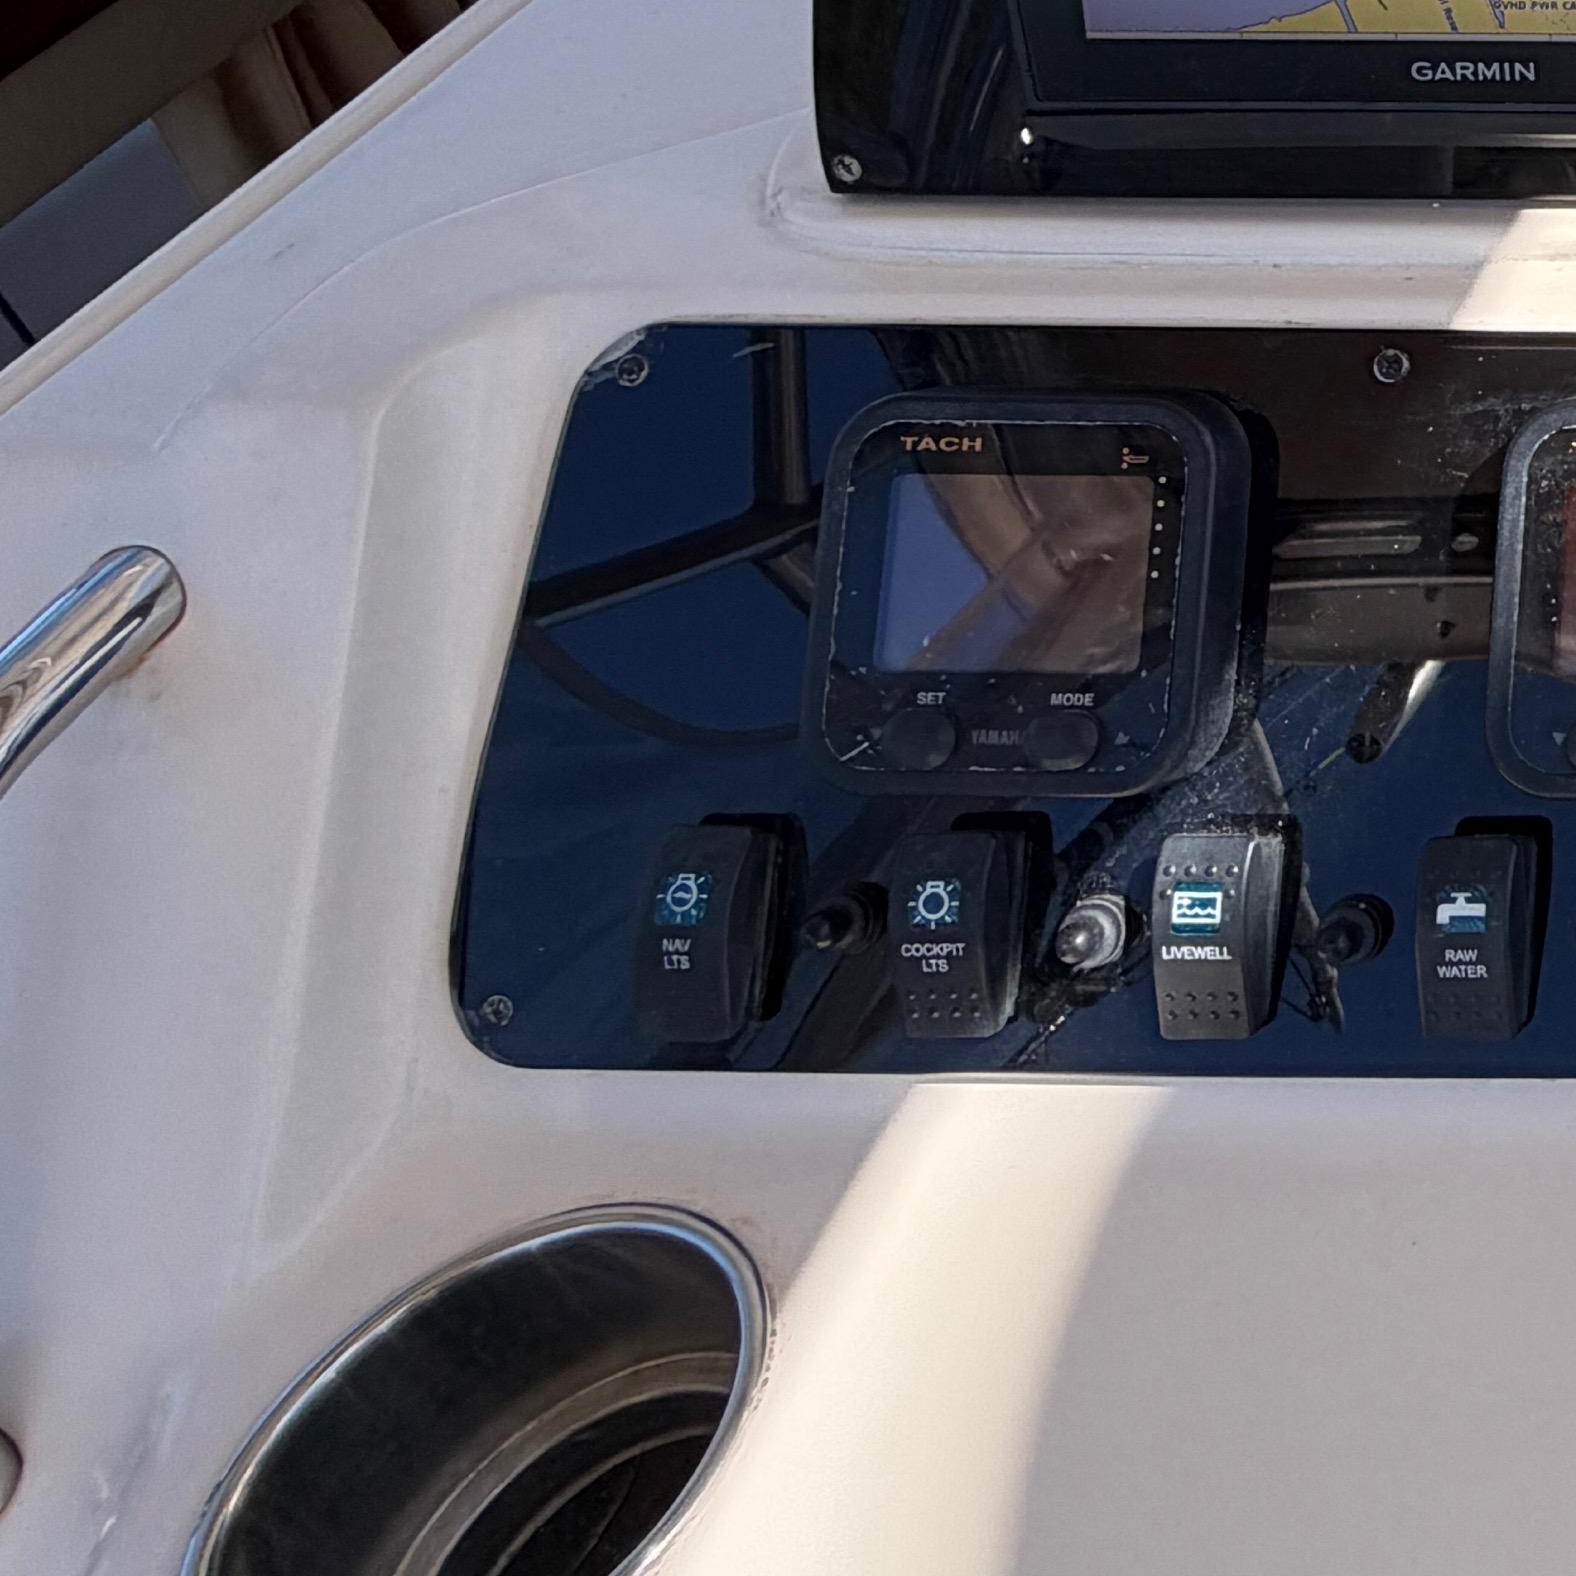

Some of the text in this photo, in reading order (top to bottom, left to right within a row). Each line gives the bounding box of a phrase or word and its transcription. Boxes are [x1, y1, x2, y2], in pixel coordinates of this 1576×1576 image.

[1410, 61, 1536, 82] GARMIN
[899, 435, 984, 454] TACH
[916, 692, 1096, 708] SET MODE
[661, 937, 693, 954] NAV
[900, 942, 966, 959] COCKPIT
[1161, 945, 1234, 963] LIVEWELL
[663, 953, 692, 970] LTS
[1444, 948, 1479, 964] RAW
[921, 958, 950, 975] LTS
[1436, 964, 1490, 980] WATER
